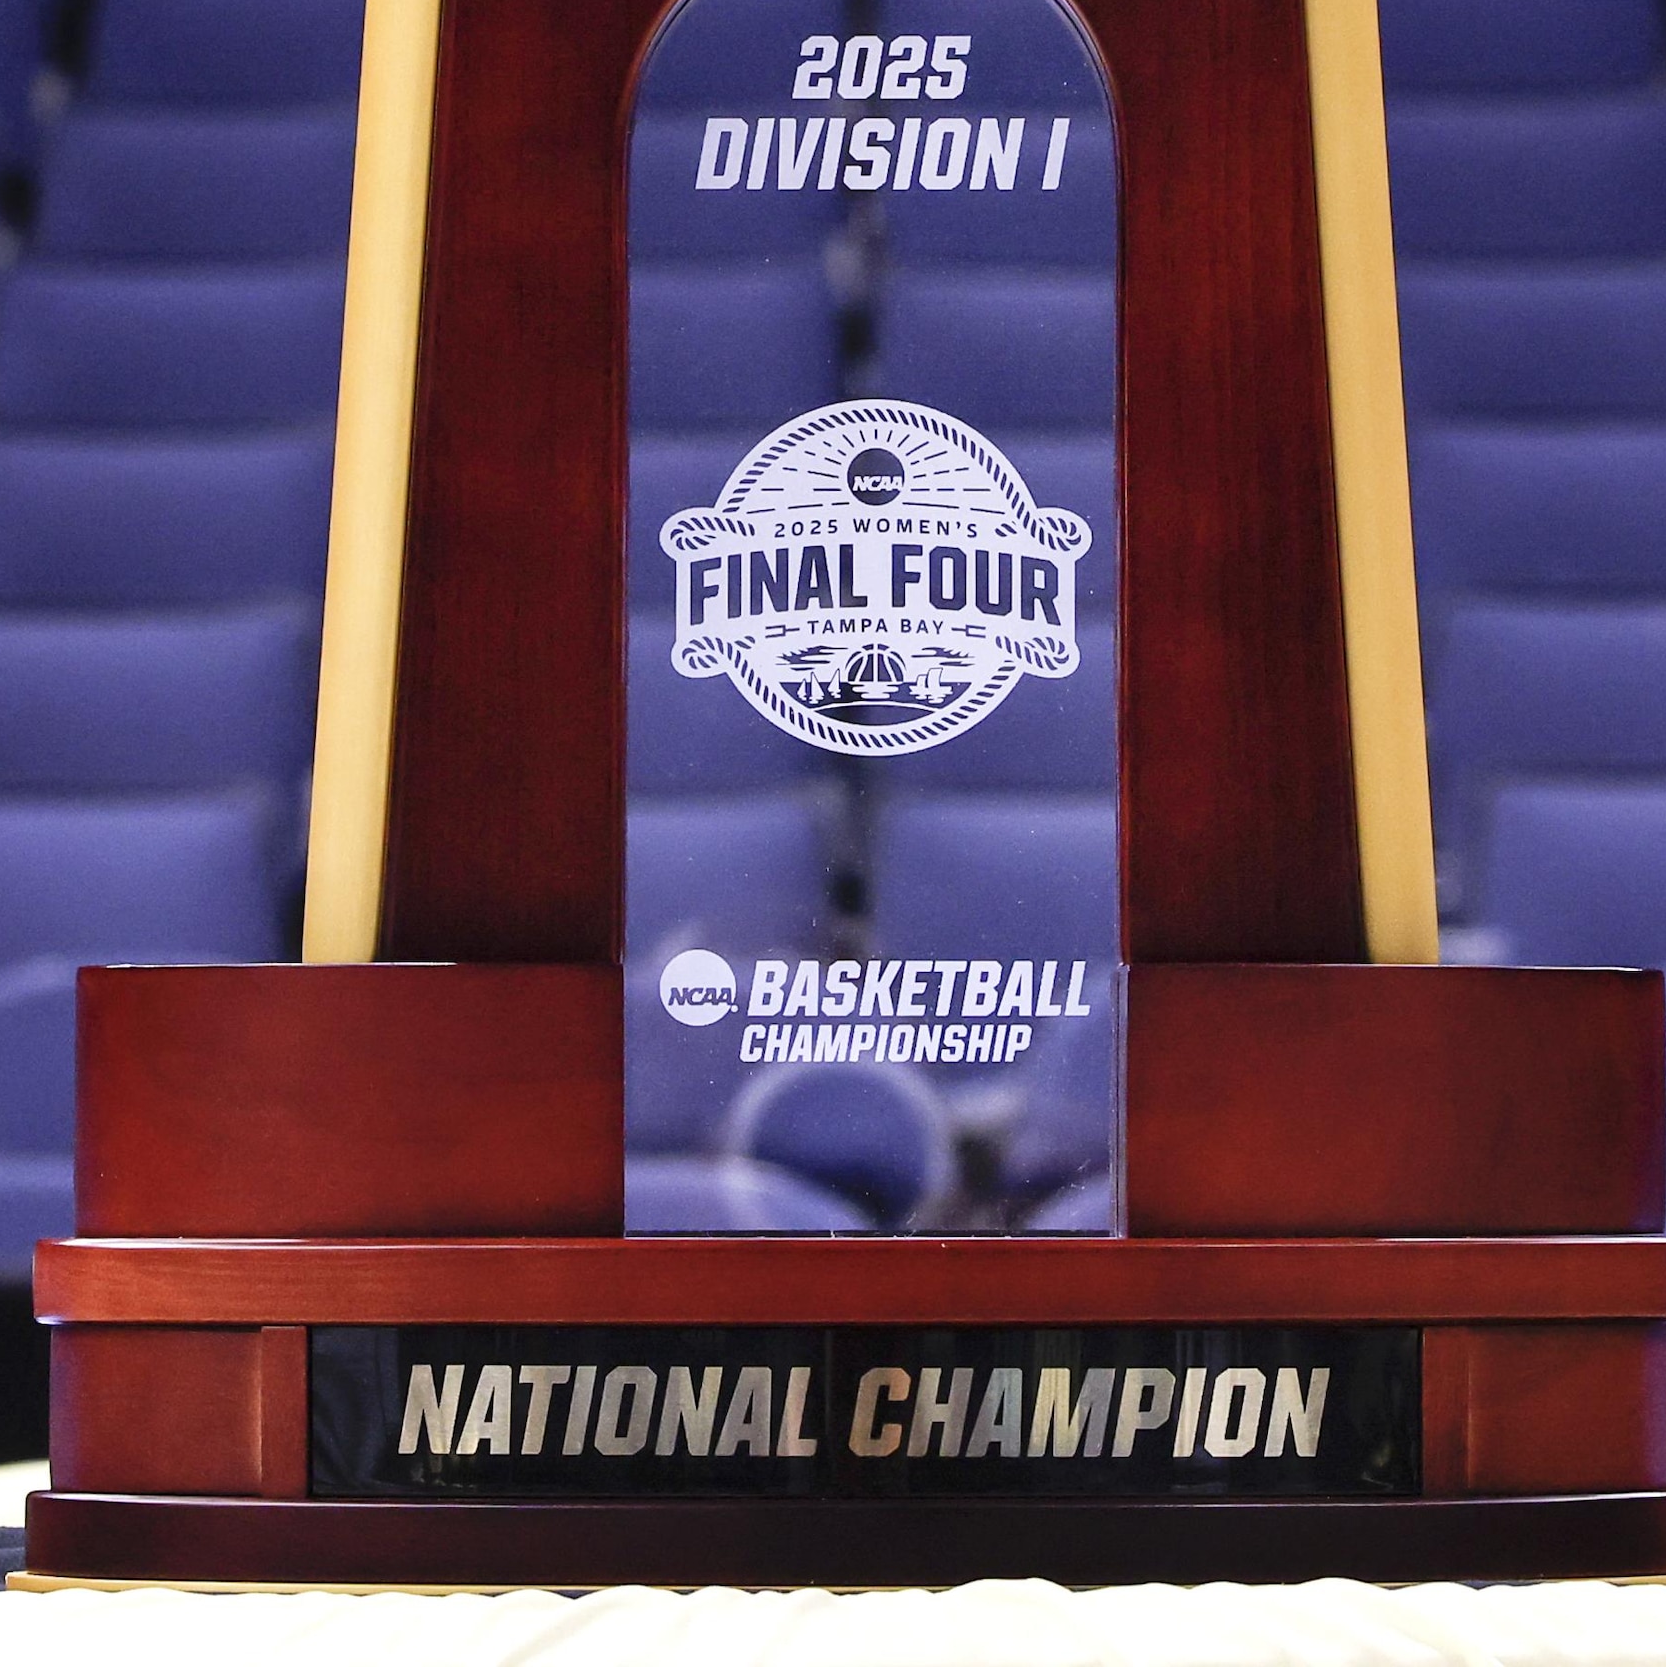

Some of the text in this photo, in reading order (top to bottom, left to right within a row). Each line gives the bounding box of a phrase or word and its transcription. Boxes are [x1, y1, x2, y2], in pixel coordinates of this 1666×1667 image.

[792, 35, 972, 100] 2025
[695, 118, 1071, 191] DIVISION I
[852, 475, 904, 493] NCAA
[774, 517, 979, 538] 2025 WOMEN'S
[689, 543, 1062, 627] FINAL FOUR
[807, 619, 945, 635] TAMPA BAY
[668, 959, 1092, 1017] NCAA BASKETBALL
[739, 1024, 1033, 1063] CHAMPIONSHIP
[397, 1364, 1331, 1459] NATIONAL CHAMPION
